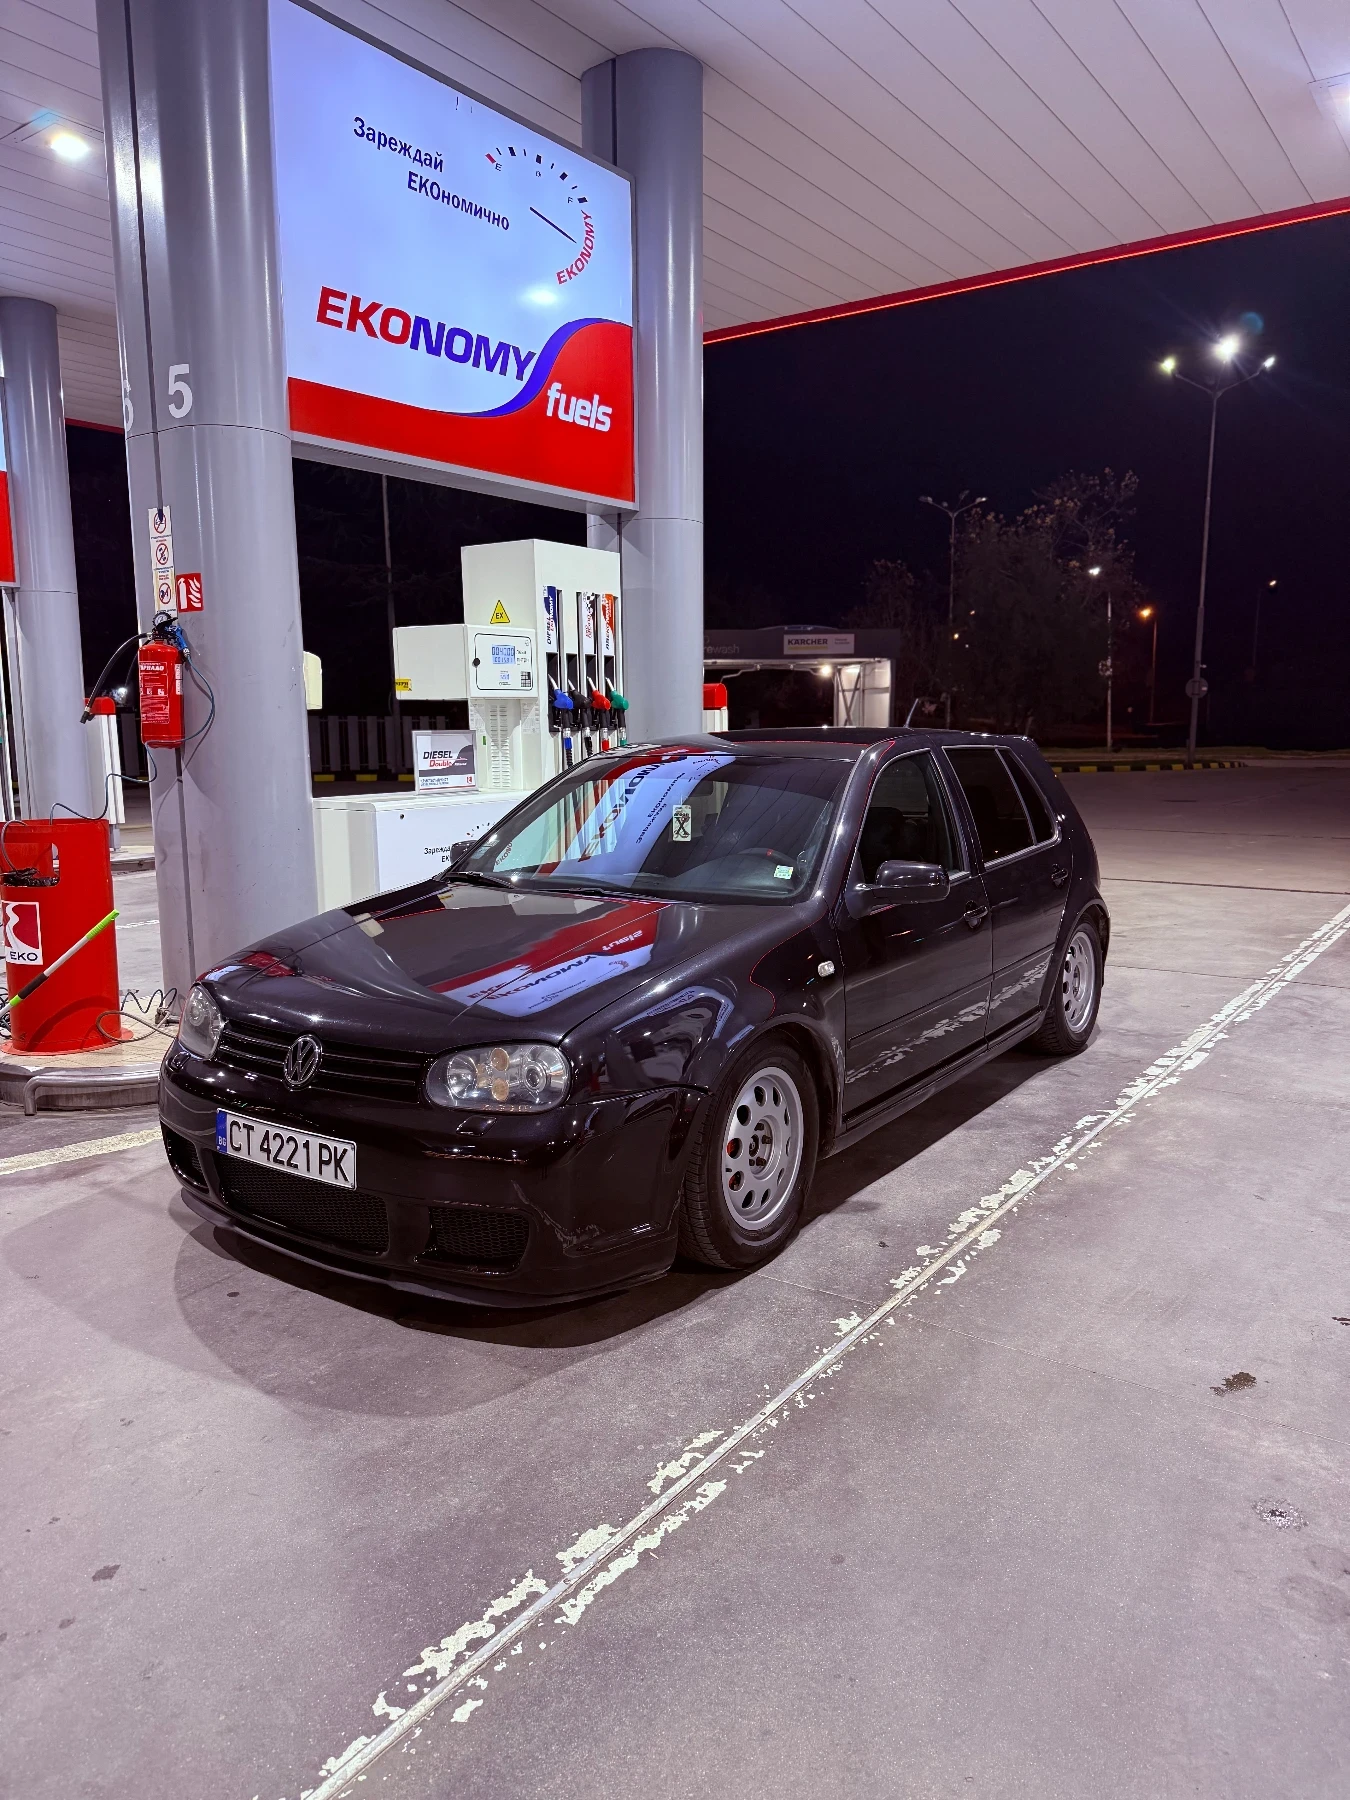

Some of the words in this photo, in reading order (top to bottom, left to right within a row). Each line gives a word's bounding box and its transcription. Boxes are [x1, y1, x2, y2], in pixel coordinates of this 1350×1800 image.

[353, 116, 444, 173] Зареждай
[407, 170, 510, 231] ЕКОномично
[555, 209, 595, 285] EKONOMY
[316, 285, 537, 382] EKONOMY
[167, 363, 193, 419] 5
[546, 382, 612, 433] fuels
[495, 612, 504, 620] EX
[423, 751, 453, 760] DIESEL
[429, 760, 453, 768] Double
[10, 951, 38, 961] EKO
[218, 1135, 227, 1147] BG
[229, 1119, 255, 1156] CT
[259, 1129, 311, 1173] 4221
[318, 1142, 349, 1183] PK
